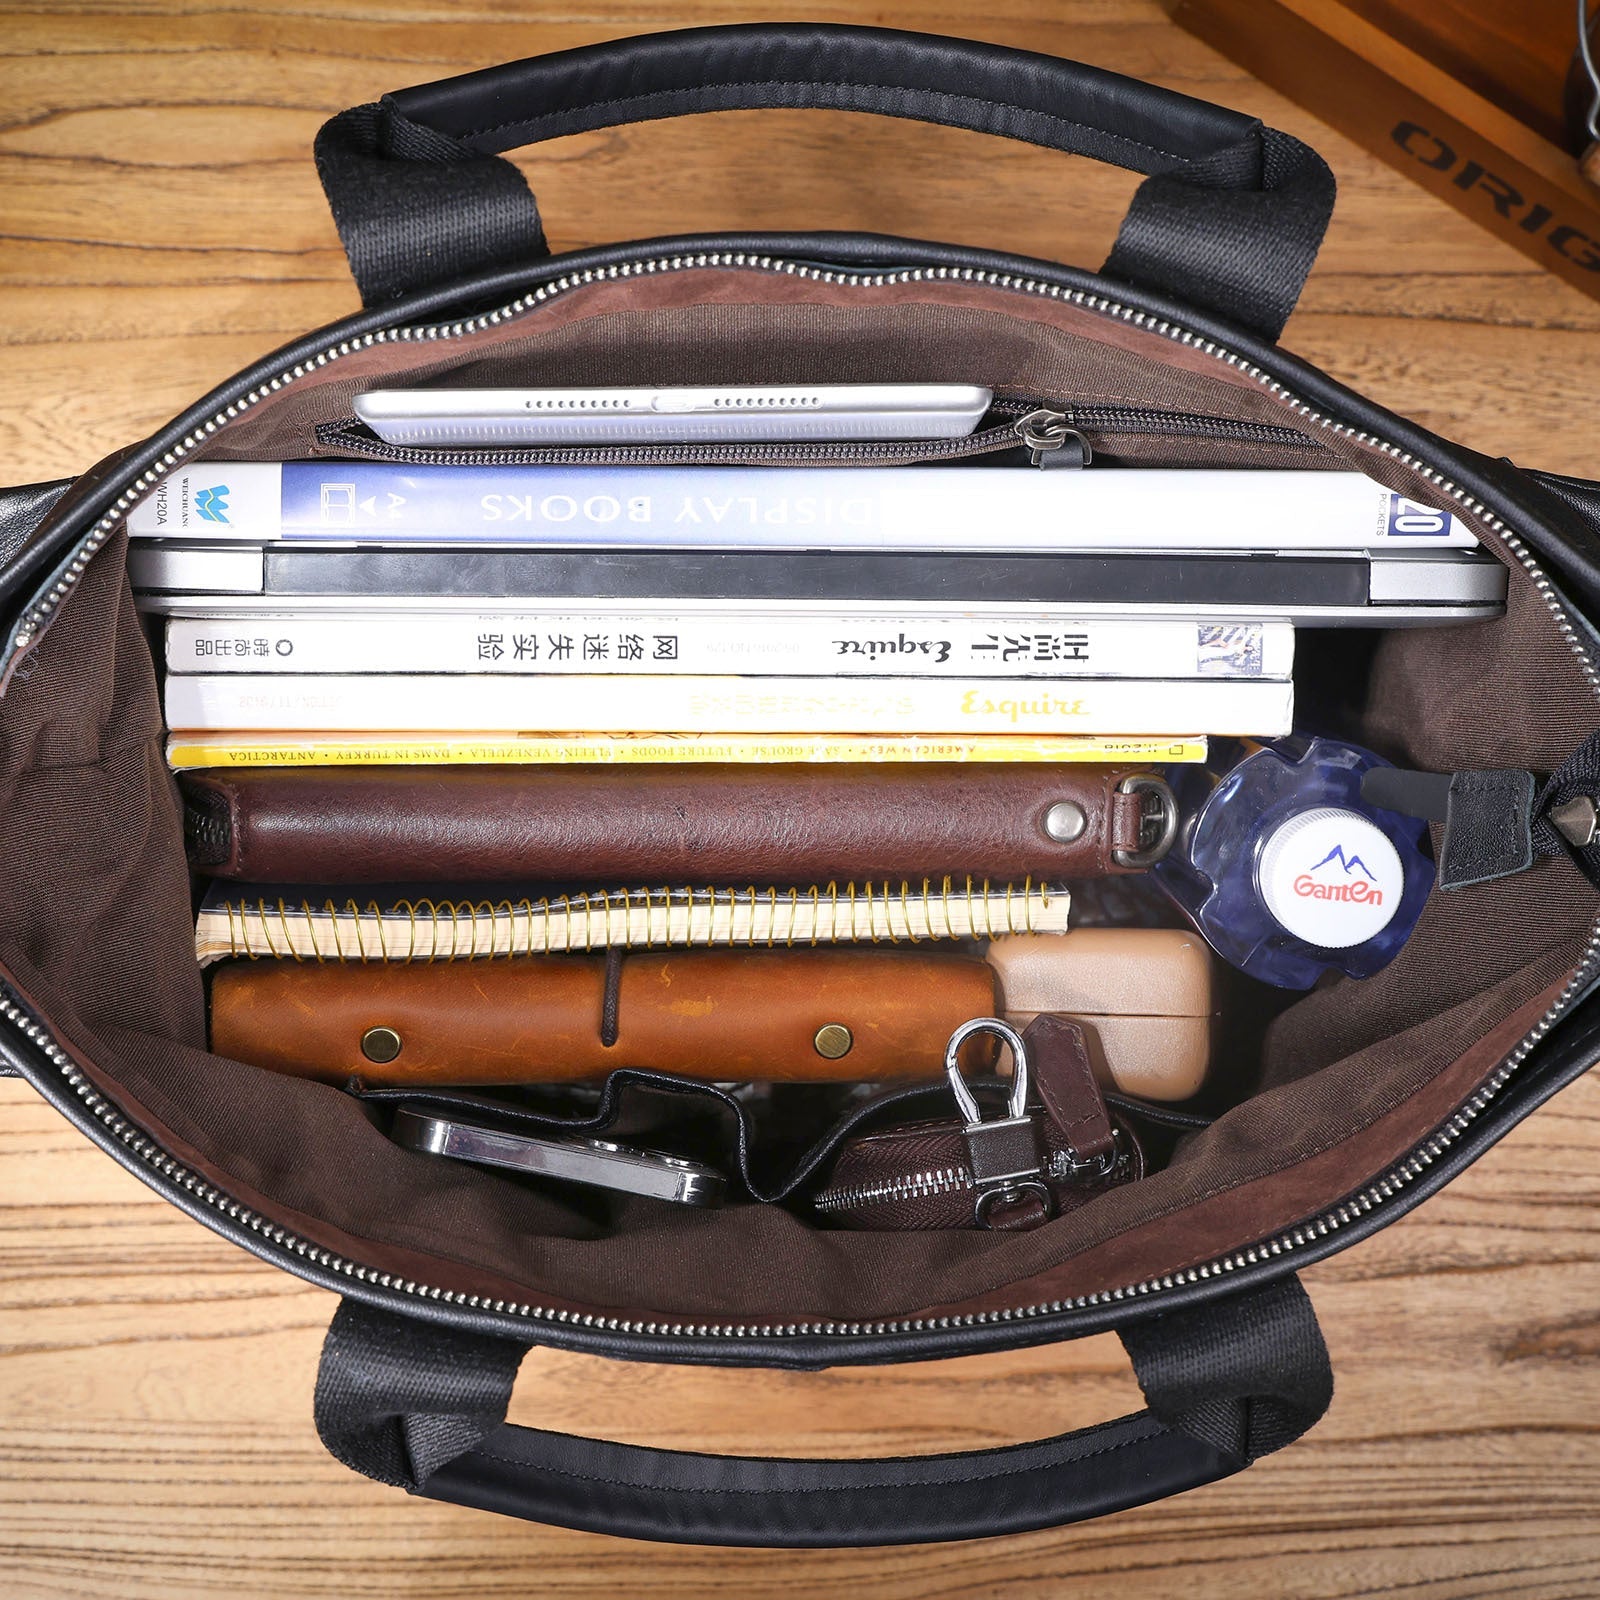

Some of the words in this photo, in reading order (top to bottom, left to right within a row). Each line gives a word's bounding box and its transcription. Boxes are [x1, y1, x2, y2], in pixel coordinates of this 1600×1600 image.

[1391, 120, 1600, 273] ORIG
[481, 494, 651, 522] BOOKS
[674, 495, 872, 524] DISPLAY
[1376, 493, 1387, 536] POCKETS
[1395, 498, 1444, 532] 20
[478, 634, 679, 661] 网络迷失实验
[832, 633, 952, 663] Esquire
[961, 690, 1091, 723] Esquire
[470, 748, 552, 758] VENEZUELA
[631, 747, 674, 756] FOODS
[676, 747, 732, 756] FUTURE
[751, 746, 803, 755] GROUSE
[810, 745, 840, 755] SAE
[858, 744, 897, 754] WEST
[902, 744, 976, 753] AMERICAN
[229, 751, 316, 761] ANTARCTICA
[336, 750, 389, 760] TURKEY
[394, 750, 409, 759] IN
[411, 749, 451, 759] DAMS
